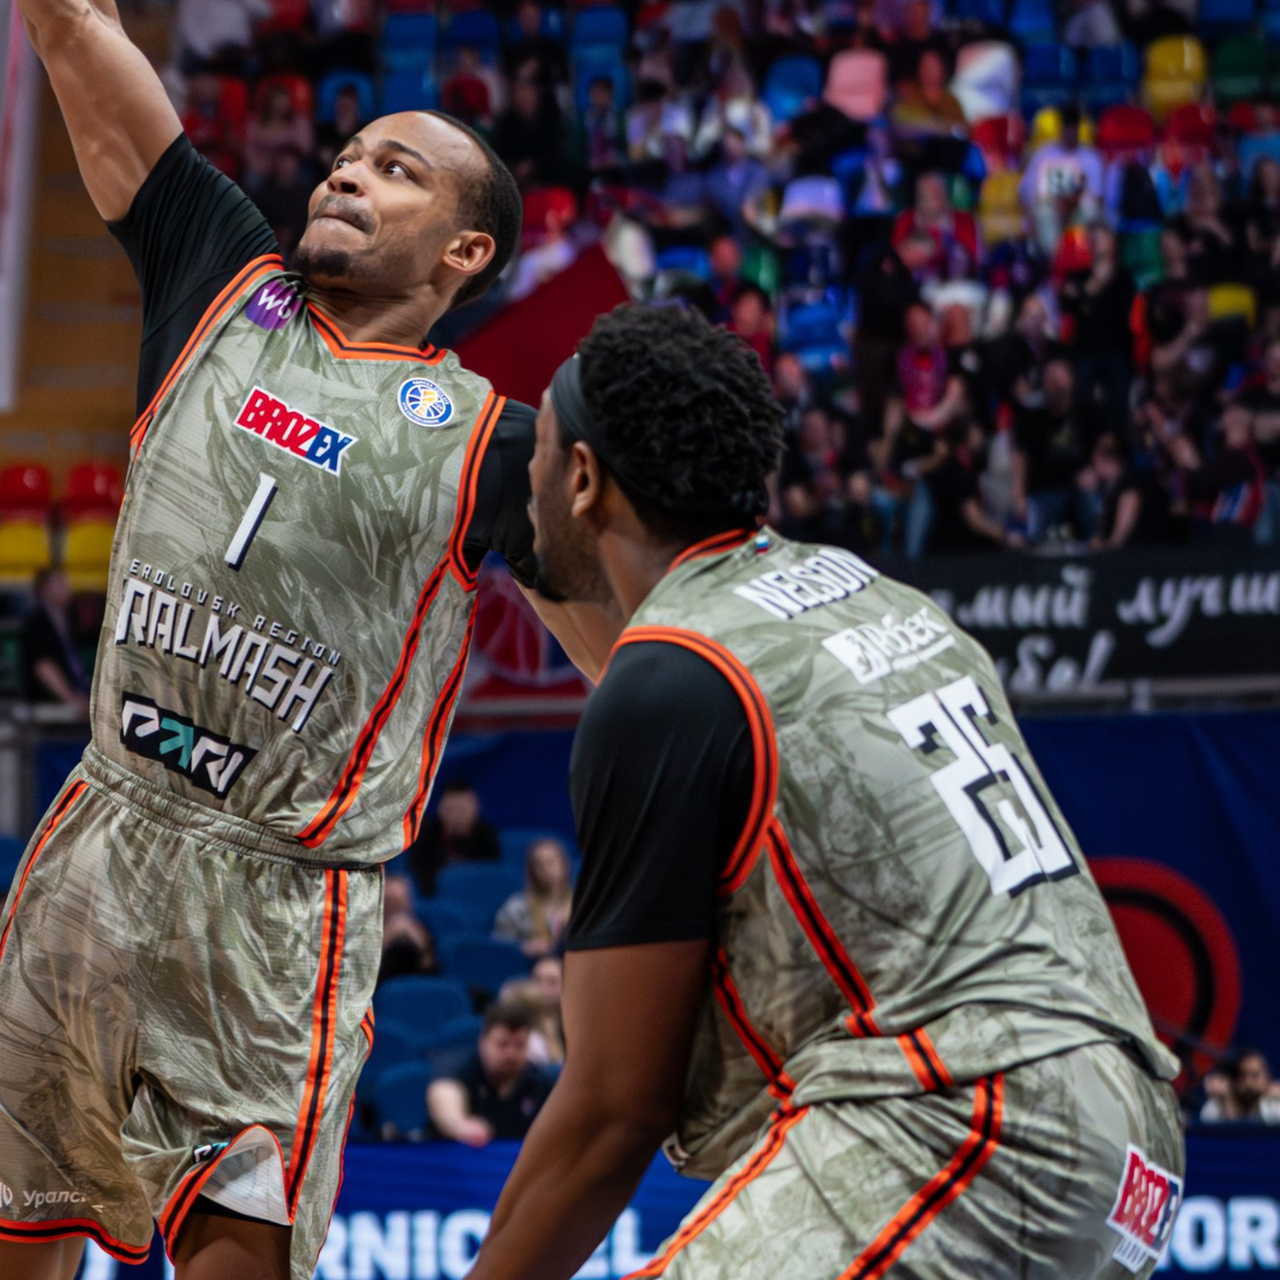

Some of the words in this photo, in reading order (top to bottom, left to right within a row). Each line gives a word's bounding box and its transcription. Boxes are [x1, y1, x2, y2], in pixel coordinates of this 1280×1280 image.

[236, 387, 353, 473] BROZEX
[223, 472, 279, 572] 1
[733, 546, 880, 620] NELSON
[114, 577, 335, 733] RALMASH
[252, 614, 342, 667] REGION
[22, 1189, 88, 1209] Уралс
[1157, 1195, 1280, 1272] OR
